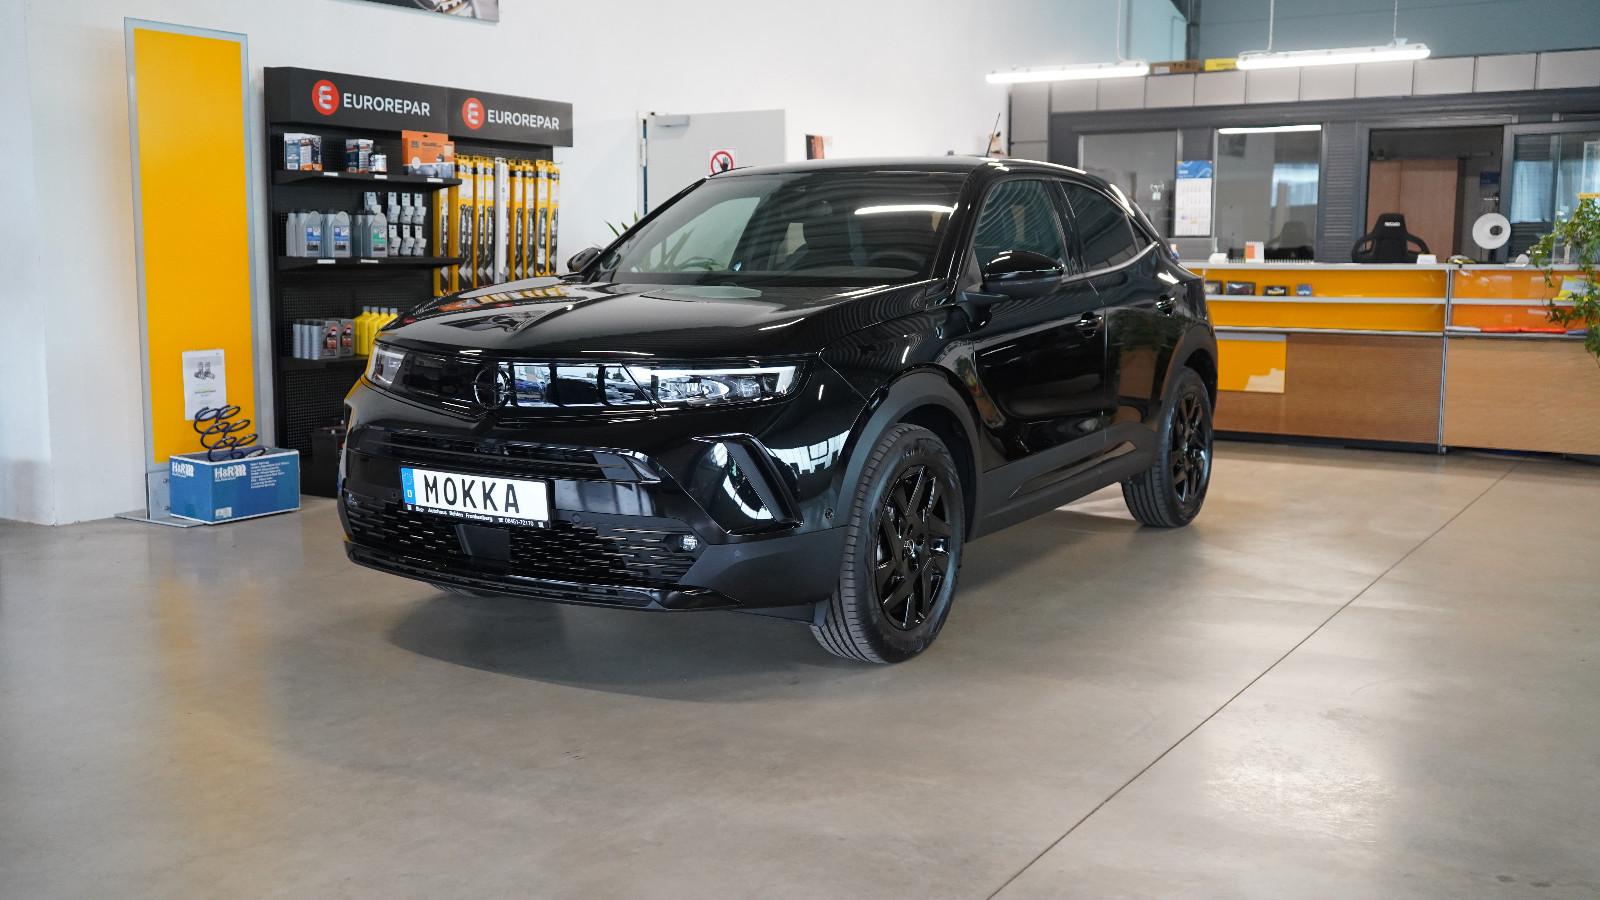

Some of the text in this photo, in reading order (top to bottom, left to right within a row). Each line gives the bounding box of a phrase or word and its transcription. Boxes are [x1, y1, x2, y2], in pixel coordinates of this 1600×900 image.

[343, 92, 431, 117] EUROREPAR
[487, 109, 560, 131] EUROREPAR
[214, 465, 236, 480] H&R
[407, 489, 413, 498] D
[423, 474, 520, 514] MOKKA
